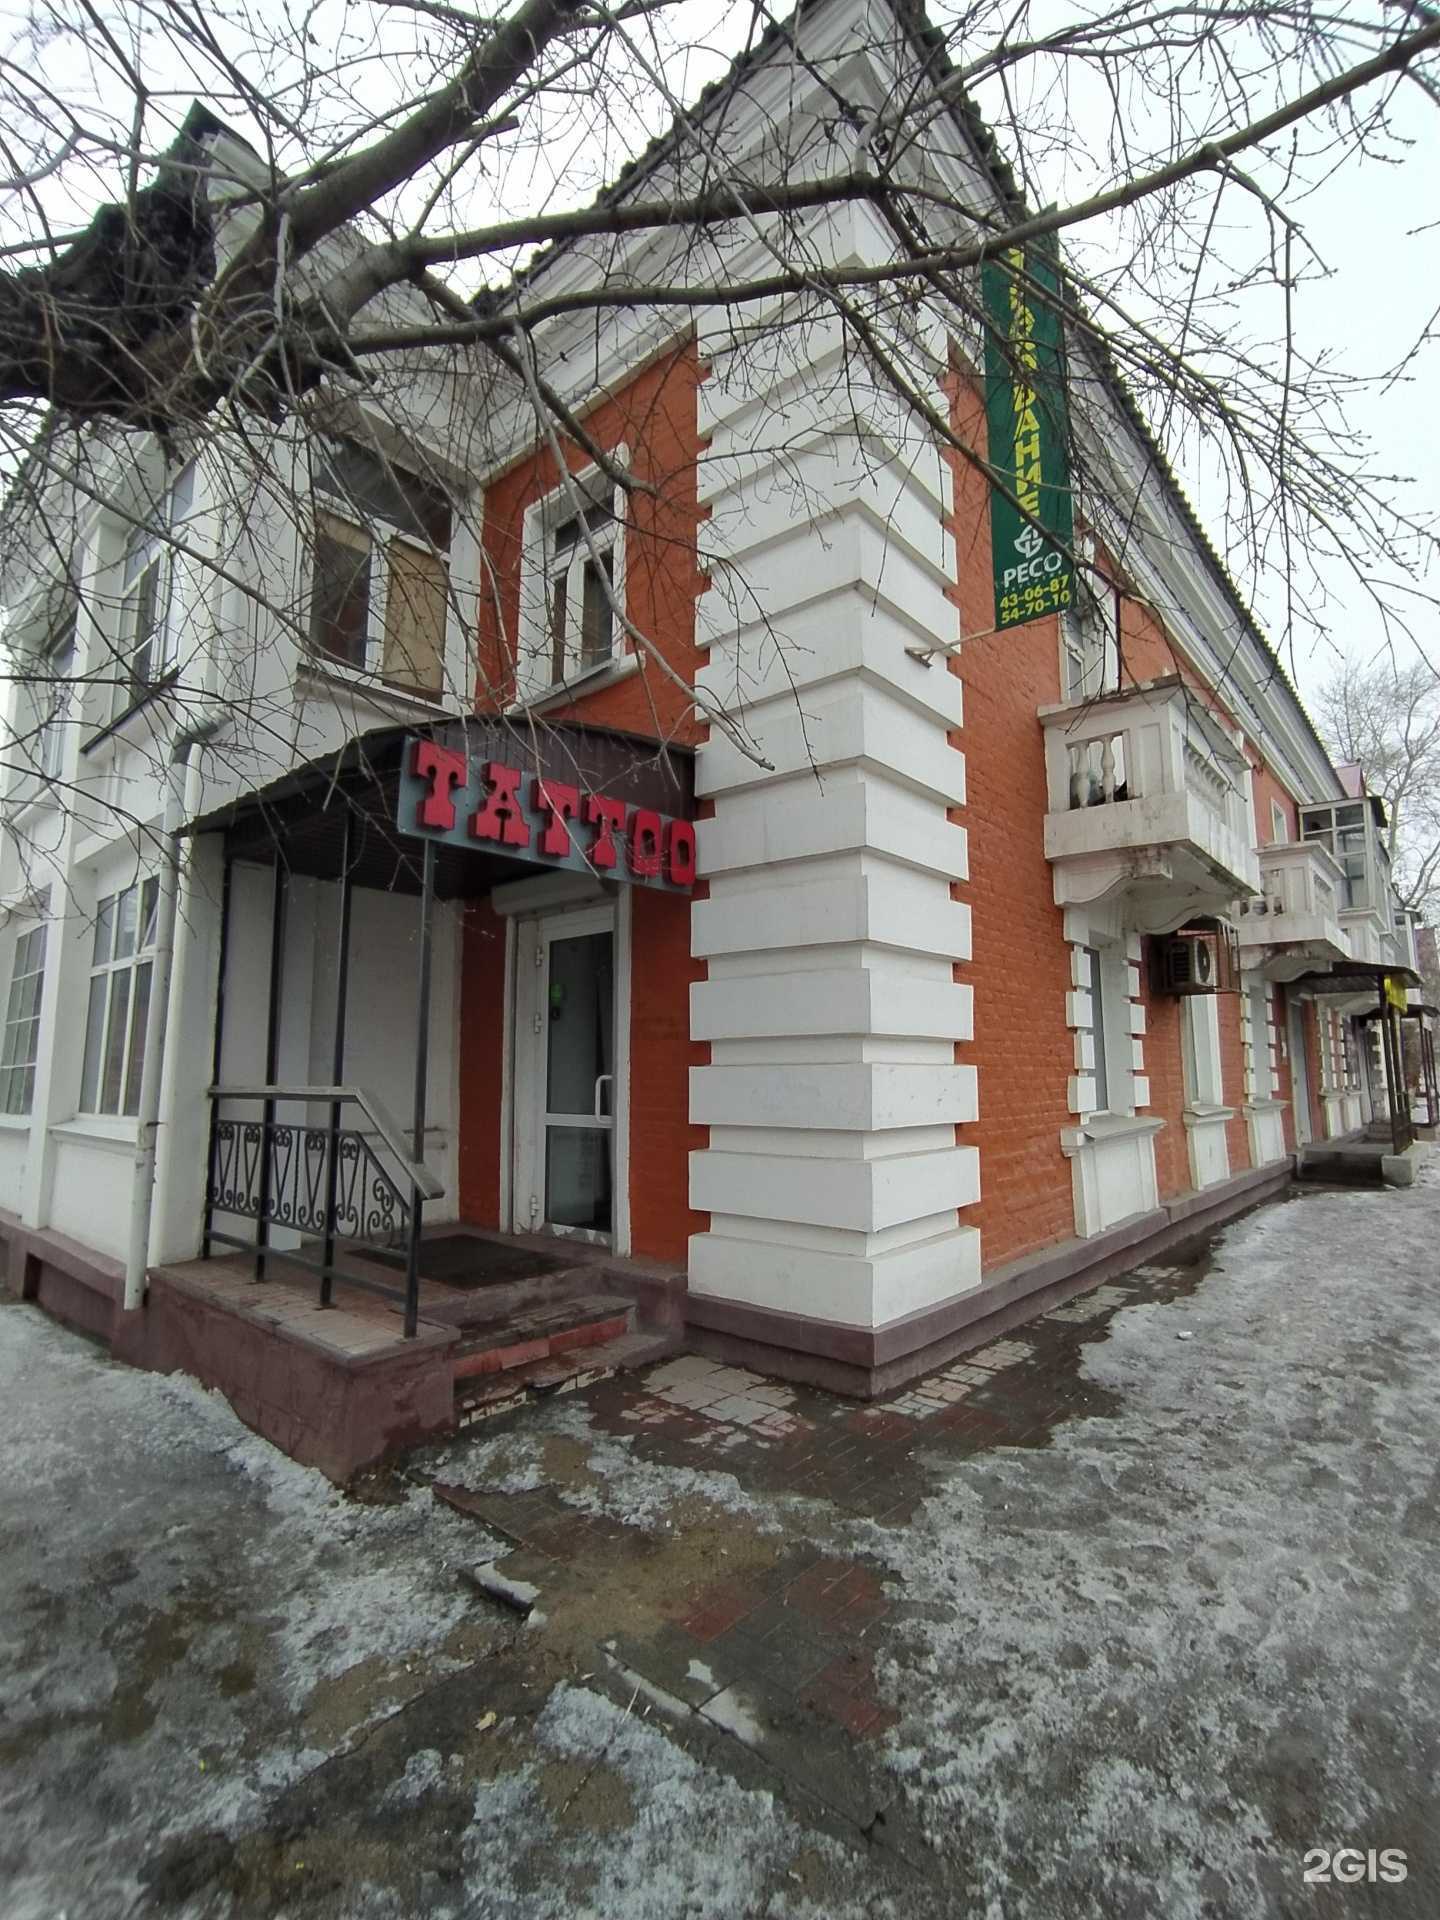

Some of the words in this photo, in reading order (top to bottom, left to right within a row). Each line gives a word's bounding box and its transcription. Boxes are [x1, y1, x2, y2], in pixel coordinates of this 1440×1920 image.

[1003, 552, 1062, 588] РЕСО
[1000, 575, 1069, 609] 43-06-87
[1001, 590, 1070, 624] 54-70-10
[410, 739, 697, 886] TATTOO
